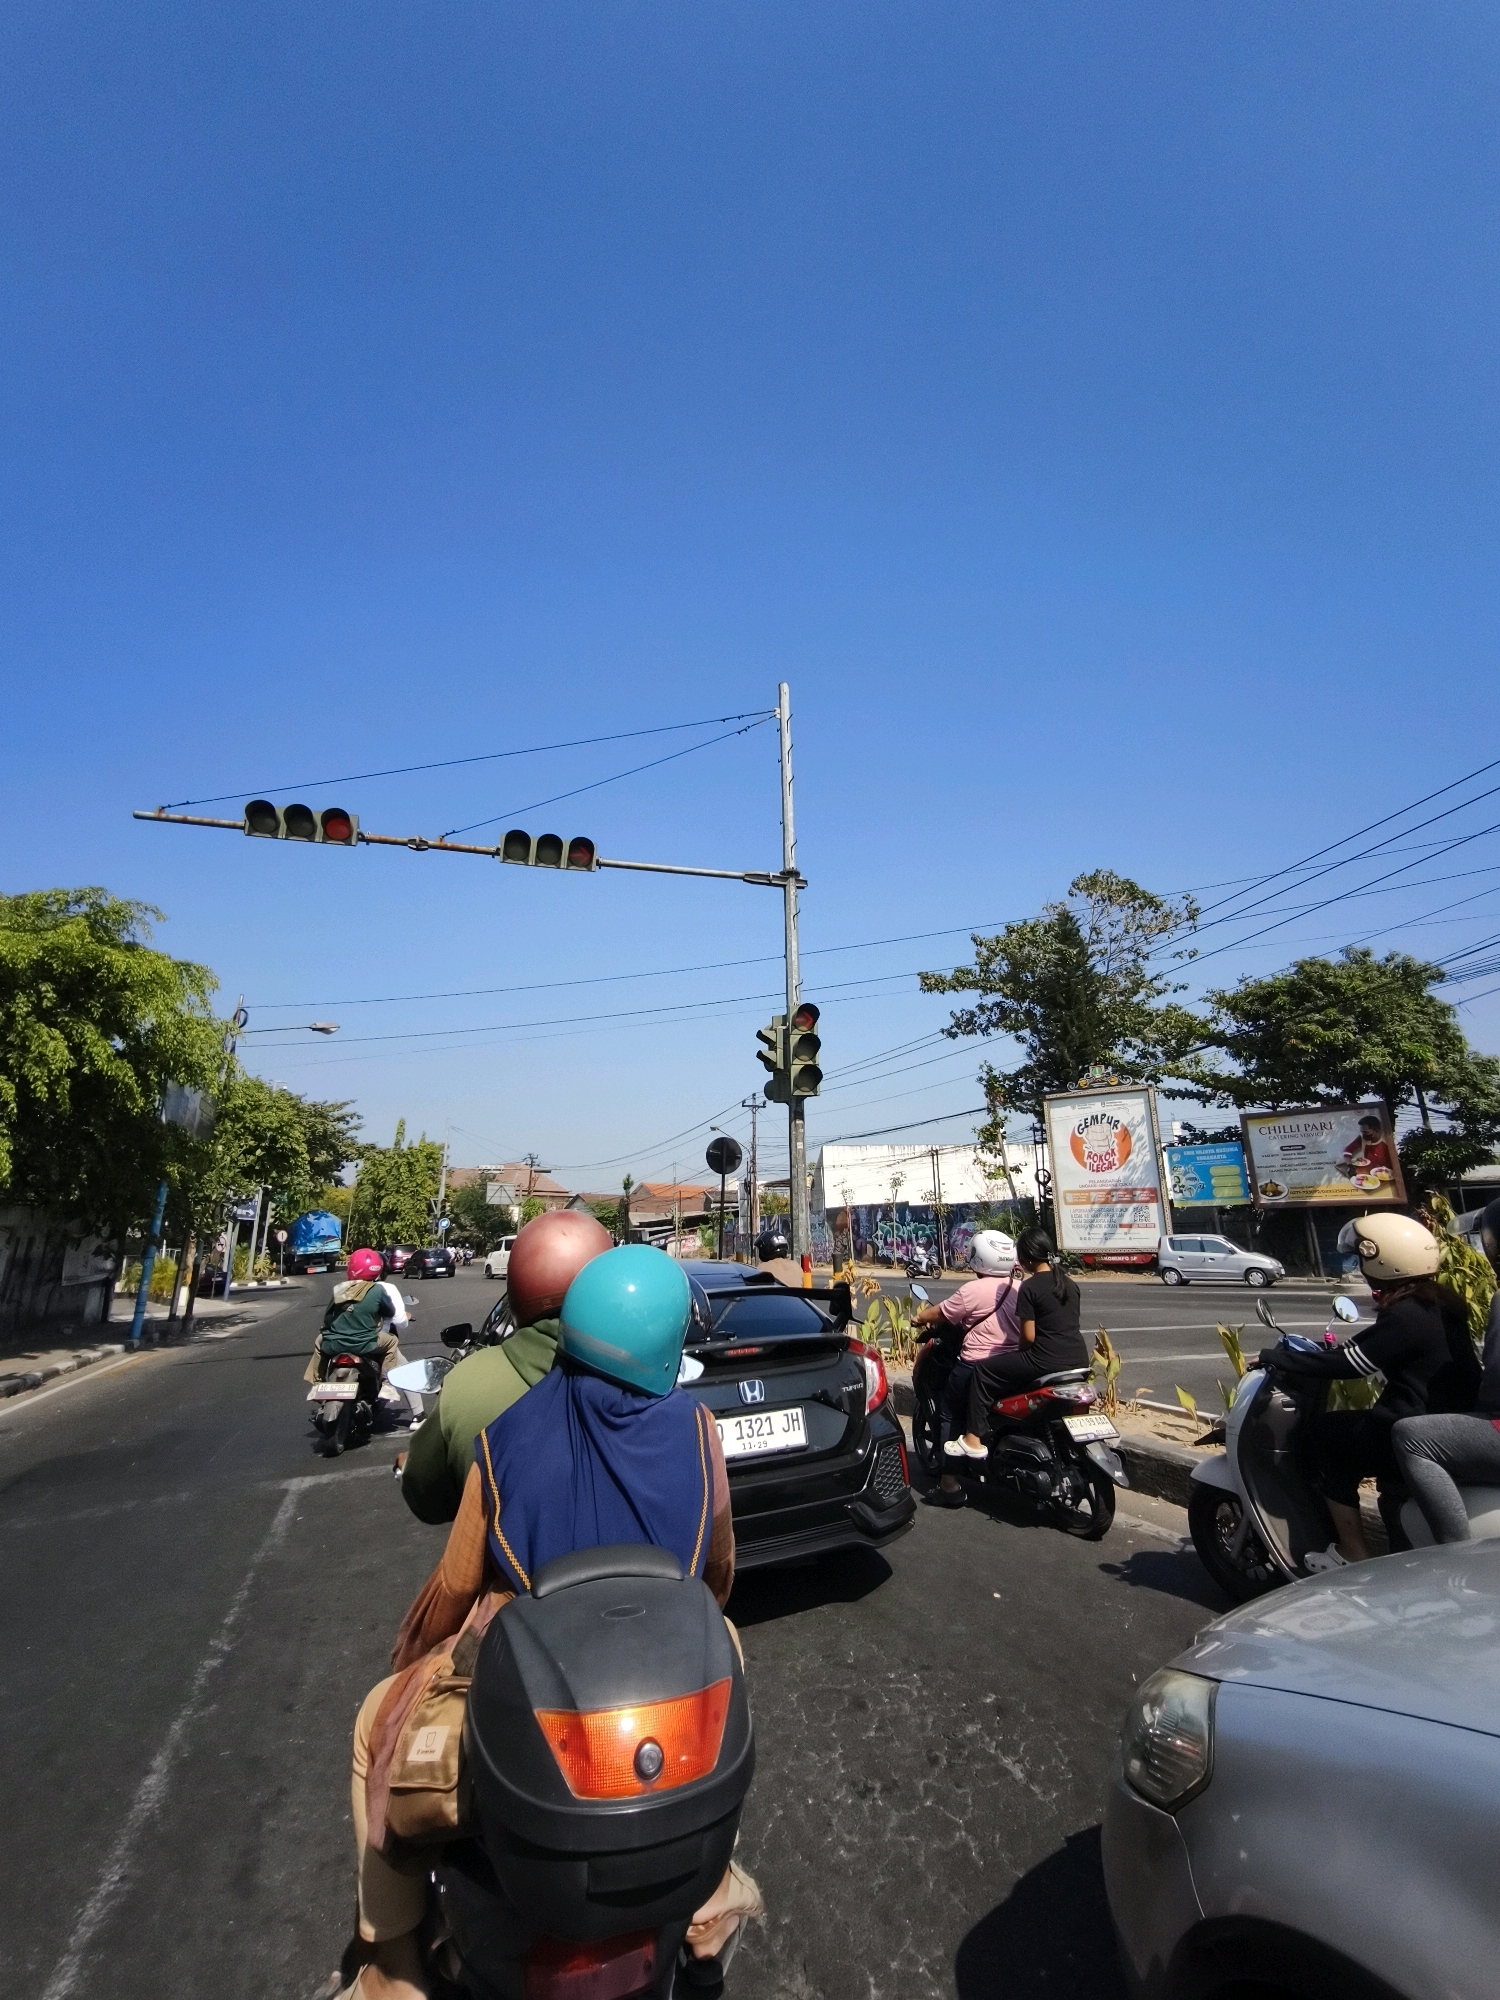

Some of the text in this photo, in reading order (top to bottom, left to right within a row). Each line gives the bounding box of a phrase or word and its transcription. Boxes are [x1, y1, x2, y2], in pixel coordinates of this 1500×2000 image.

[1077, 1113, 1120, 1135] GEMPUR
[1258, 1121, 1334, 1136] CHILLI PARI
[1268, 1131, 1329, 1141] CATERING SERVICES
[1086, 1148, 1117, 1163] ROKOK
[1088, 1160, 1117, 1173] ILEGAL
[734, 1415, 775, 1441] 1321
[782, 1411, 801, 1433] JH
